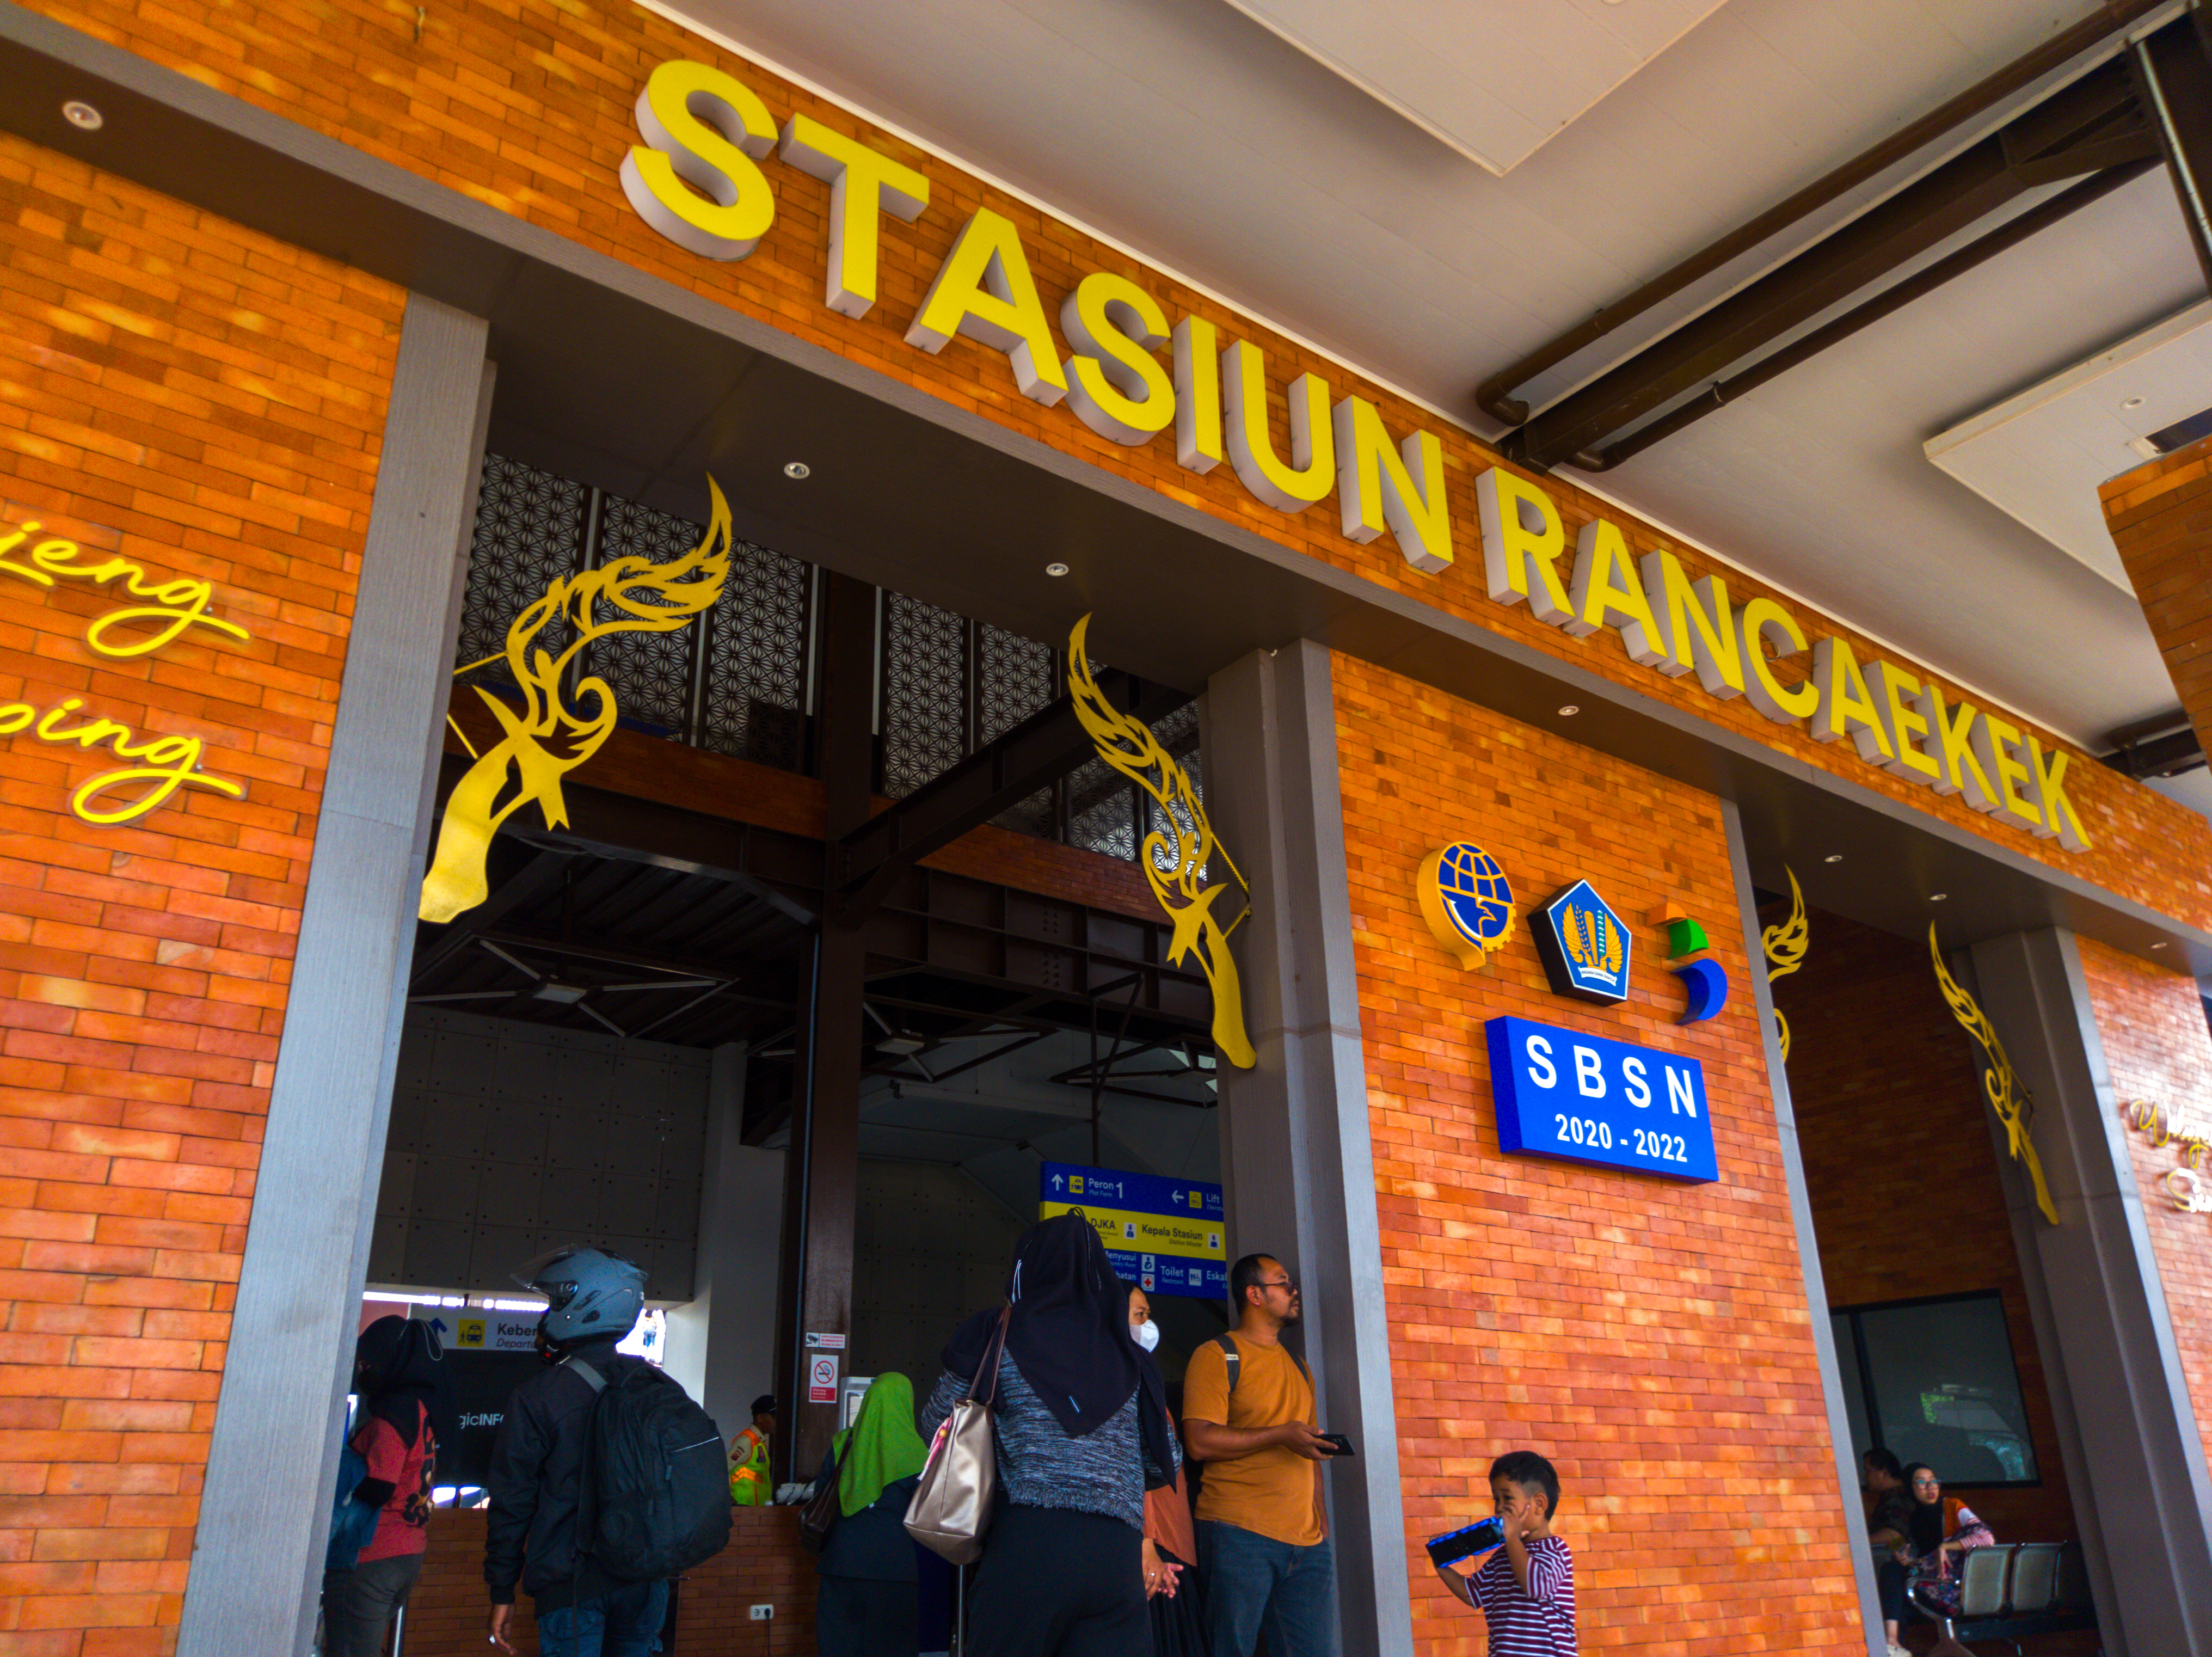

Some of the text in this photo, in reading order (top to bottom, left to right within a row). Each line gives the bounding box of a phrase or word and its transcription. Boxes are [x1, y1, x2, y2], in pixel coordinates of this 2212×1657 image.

[619, 60, 2093, 853] STASIUN RANCAEKEK
[1555, 1114, 1612, 1149] 2020
[1633, 1129, 1687, 1162] 2022
[1089, 1178, 1123, 1199] Peron 1
[1206, 1193, 1220, 1204] Lift
[1090, 1218, 1116, 1230] DJKA
[1142, 1224, 1202, 1240] Kepala Stasiun
[1116, 1271, 1136, 1281] hatan
[1160, 1266, 1184, 1277] Toilet
[1206, 1270, 1226, 1281] Eskal
[497, 1323, 538, 1336] Keber
[496, 1337, 534, 1349] Departu
